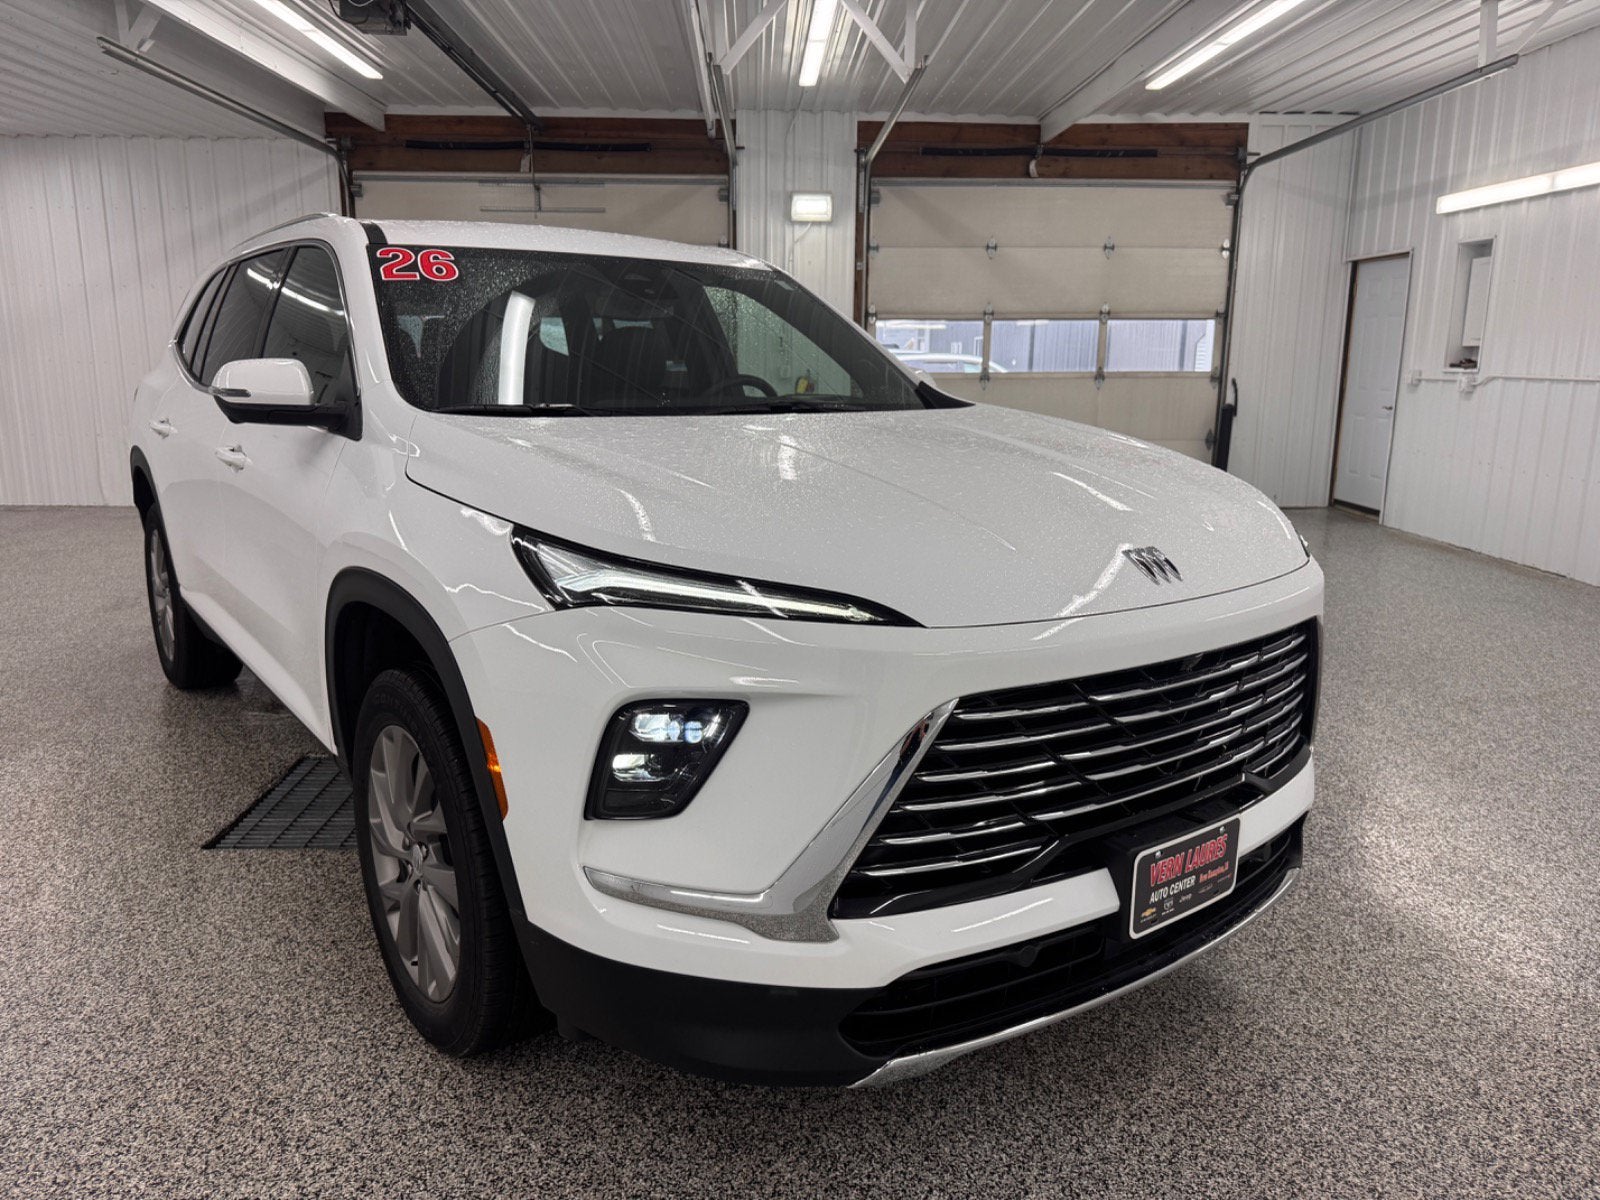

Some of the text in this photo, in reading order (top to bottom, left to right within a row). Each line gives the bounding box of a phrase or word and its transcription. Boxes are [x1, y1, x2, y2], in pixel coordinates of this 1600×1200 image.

[377, 247, 459, 281] 26
[1150, 834, 1228, 886] VERN LAURES
[1149, 886, 1168, 904] AUTO
[1169, 875, 1196, 895] CENTER
